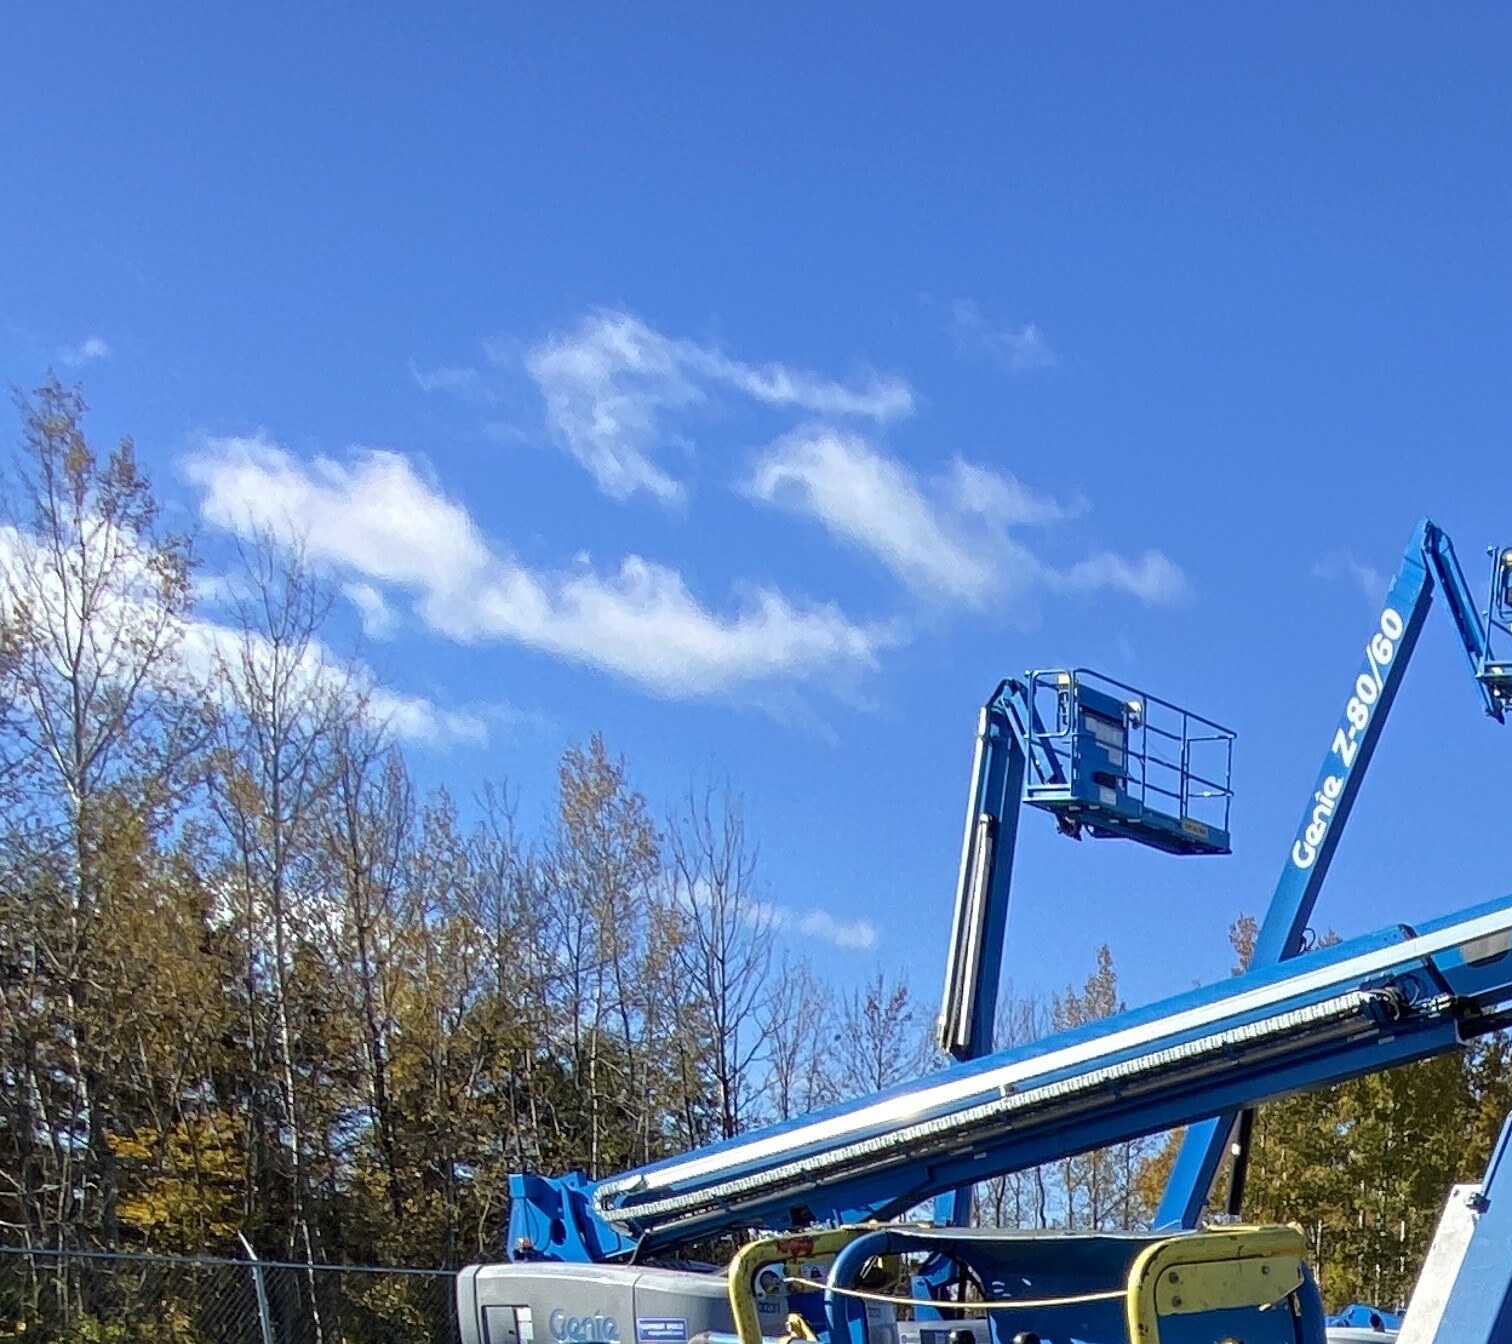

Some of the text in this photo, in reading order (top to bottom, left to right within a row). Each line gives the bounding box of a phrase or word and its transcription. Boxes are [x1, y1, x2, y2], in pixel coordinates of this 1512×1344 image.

[1292, 607, 1404, 869] Genie Z-80/60
[549, 1308, 620, 1341] Genie
